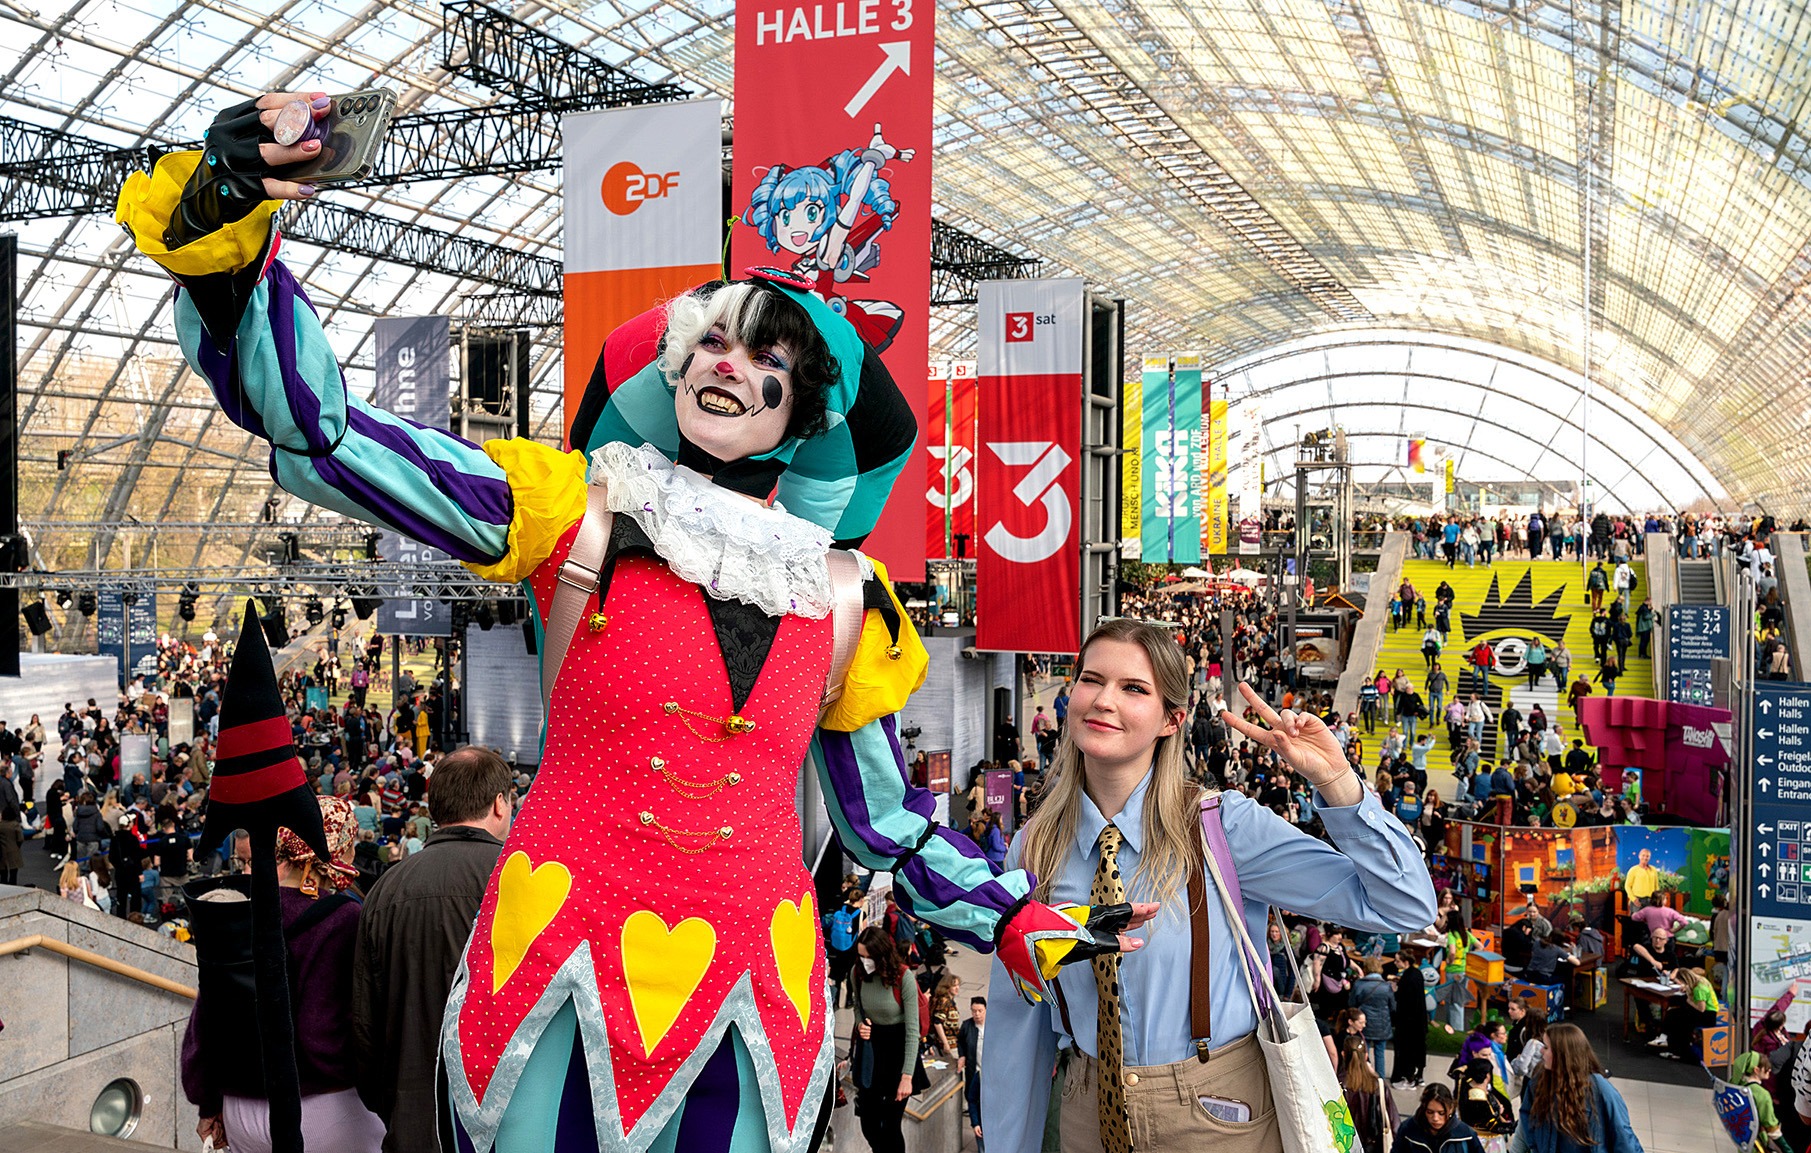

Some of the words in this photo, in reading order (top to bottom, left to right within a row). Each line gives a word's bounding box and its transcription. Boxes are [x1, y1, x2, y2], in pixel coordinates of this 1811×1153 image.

[756, 0, 880, 46] HALLE
[890, 0, 914, 31] 3
[626, 171, 680, 202] ZDF
[1190, 429, 1201, 449] ZDF
[1214, 430, 1222, 460] HALLE
[1131, 459, 1139, 482] UND
[1190, 452, 1201, 472] und
[1190, 474, 1201, 496] ARD
[983, 441, 1072, 563] 3
[1130, 485, 1139, 529] MENSCH
[1192, 499, 1201, 518] von
[1213, 499, 1222, 544] UKRAINE
[1702, 609, 1721, 622] 3,5
[1702, 622, 1721, 635] 2,4
[1778, 696, 1809, 708] Hallen
[1778, 708, 1803, 719] Halls
[1778, 723, 1809, 734] Hallen
[1778, 735, 1802, 746] Halls
[1778, 750, 1811, 763] Freigel
[1777, 777, 1811, 790] Eingan
[1779, 823, 1798, 831] EXIT
